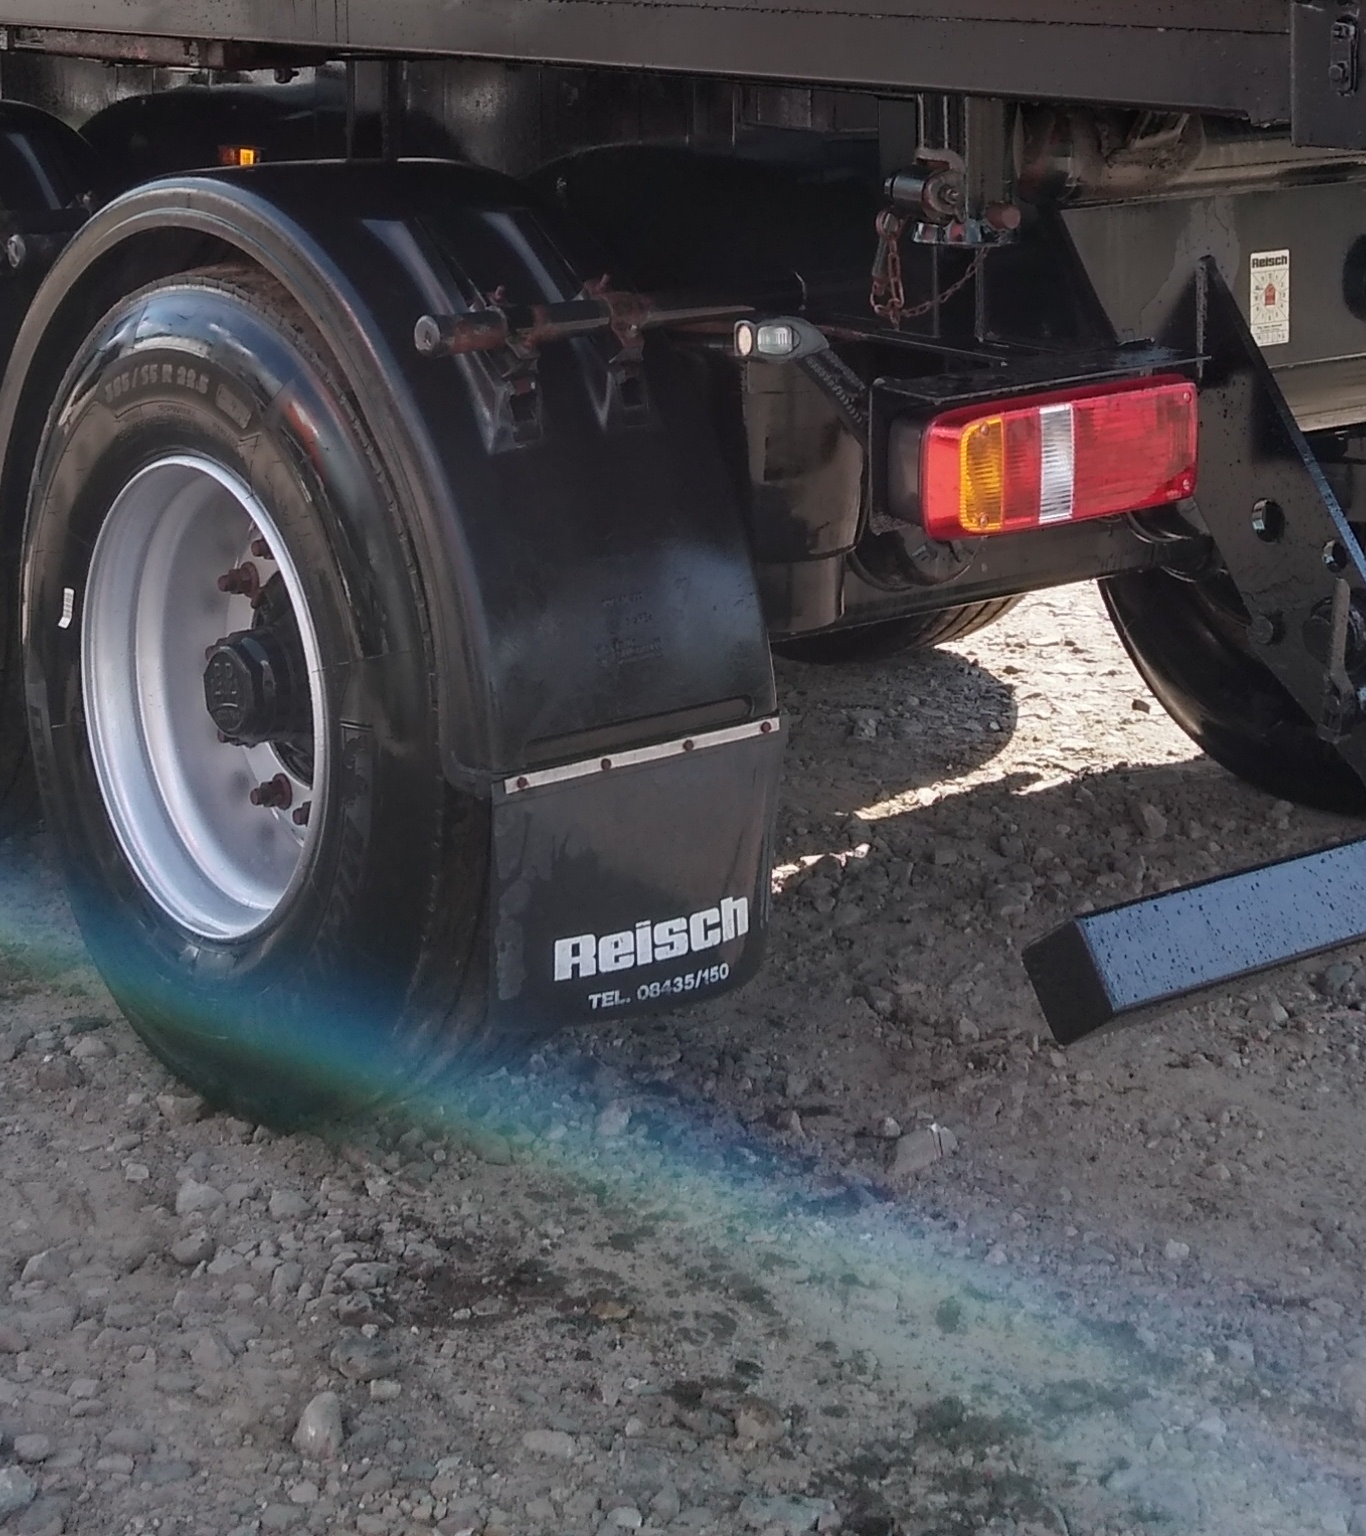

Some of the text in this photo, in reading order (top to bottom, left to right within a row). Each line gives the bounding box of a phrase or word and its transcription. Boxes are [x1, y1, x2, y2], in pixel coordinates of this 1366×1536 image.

[1251, 255, 1288, 269] Reisch
[554, 896, 750, 982] Reisch
[588, 962, 730, 1010] TEL. 08435/150
